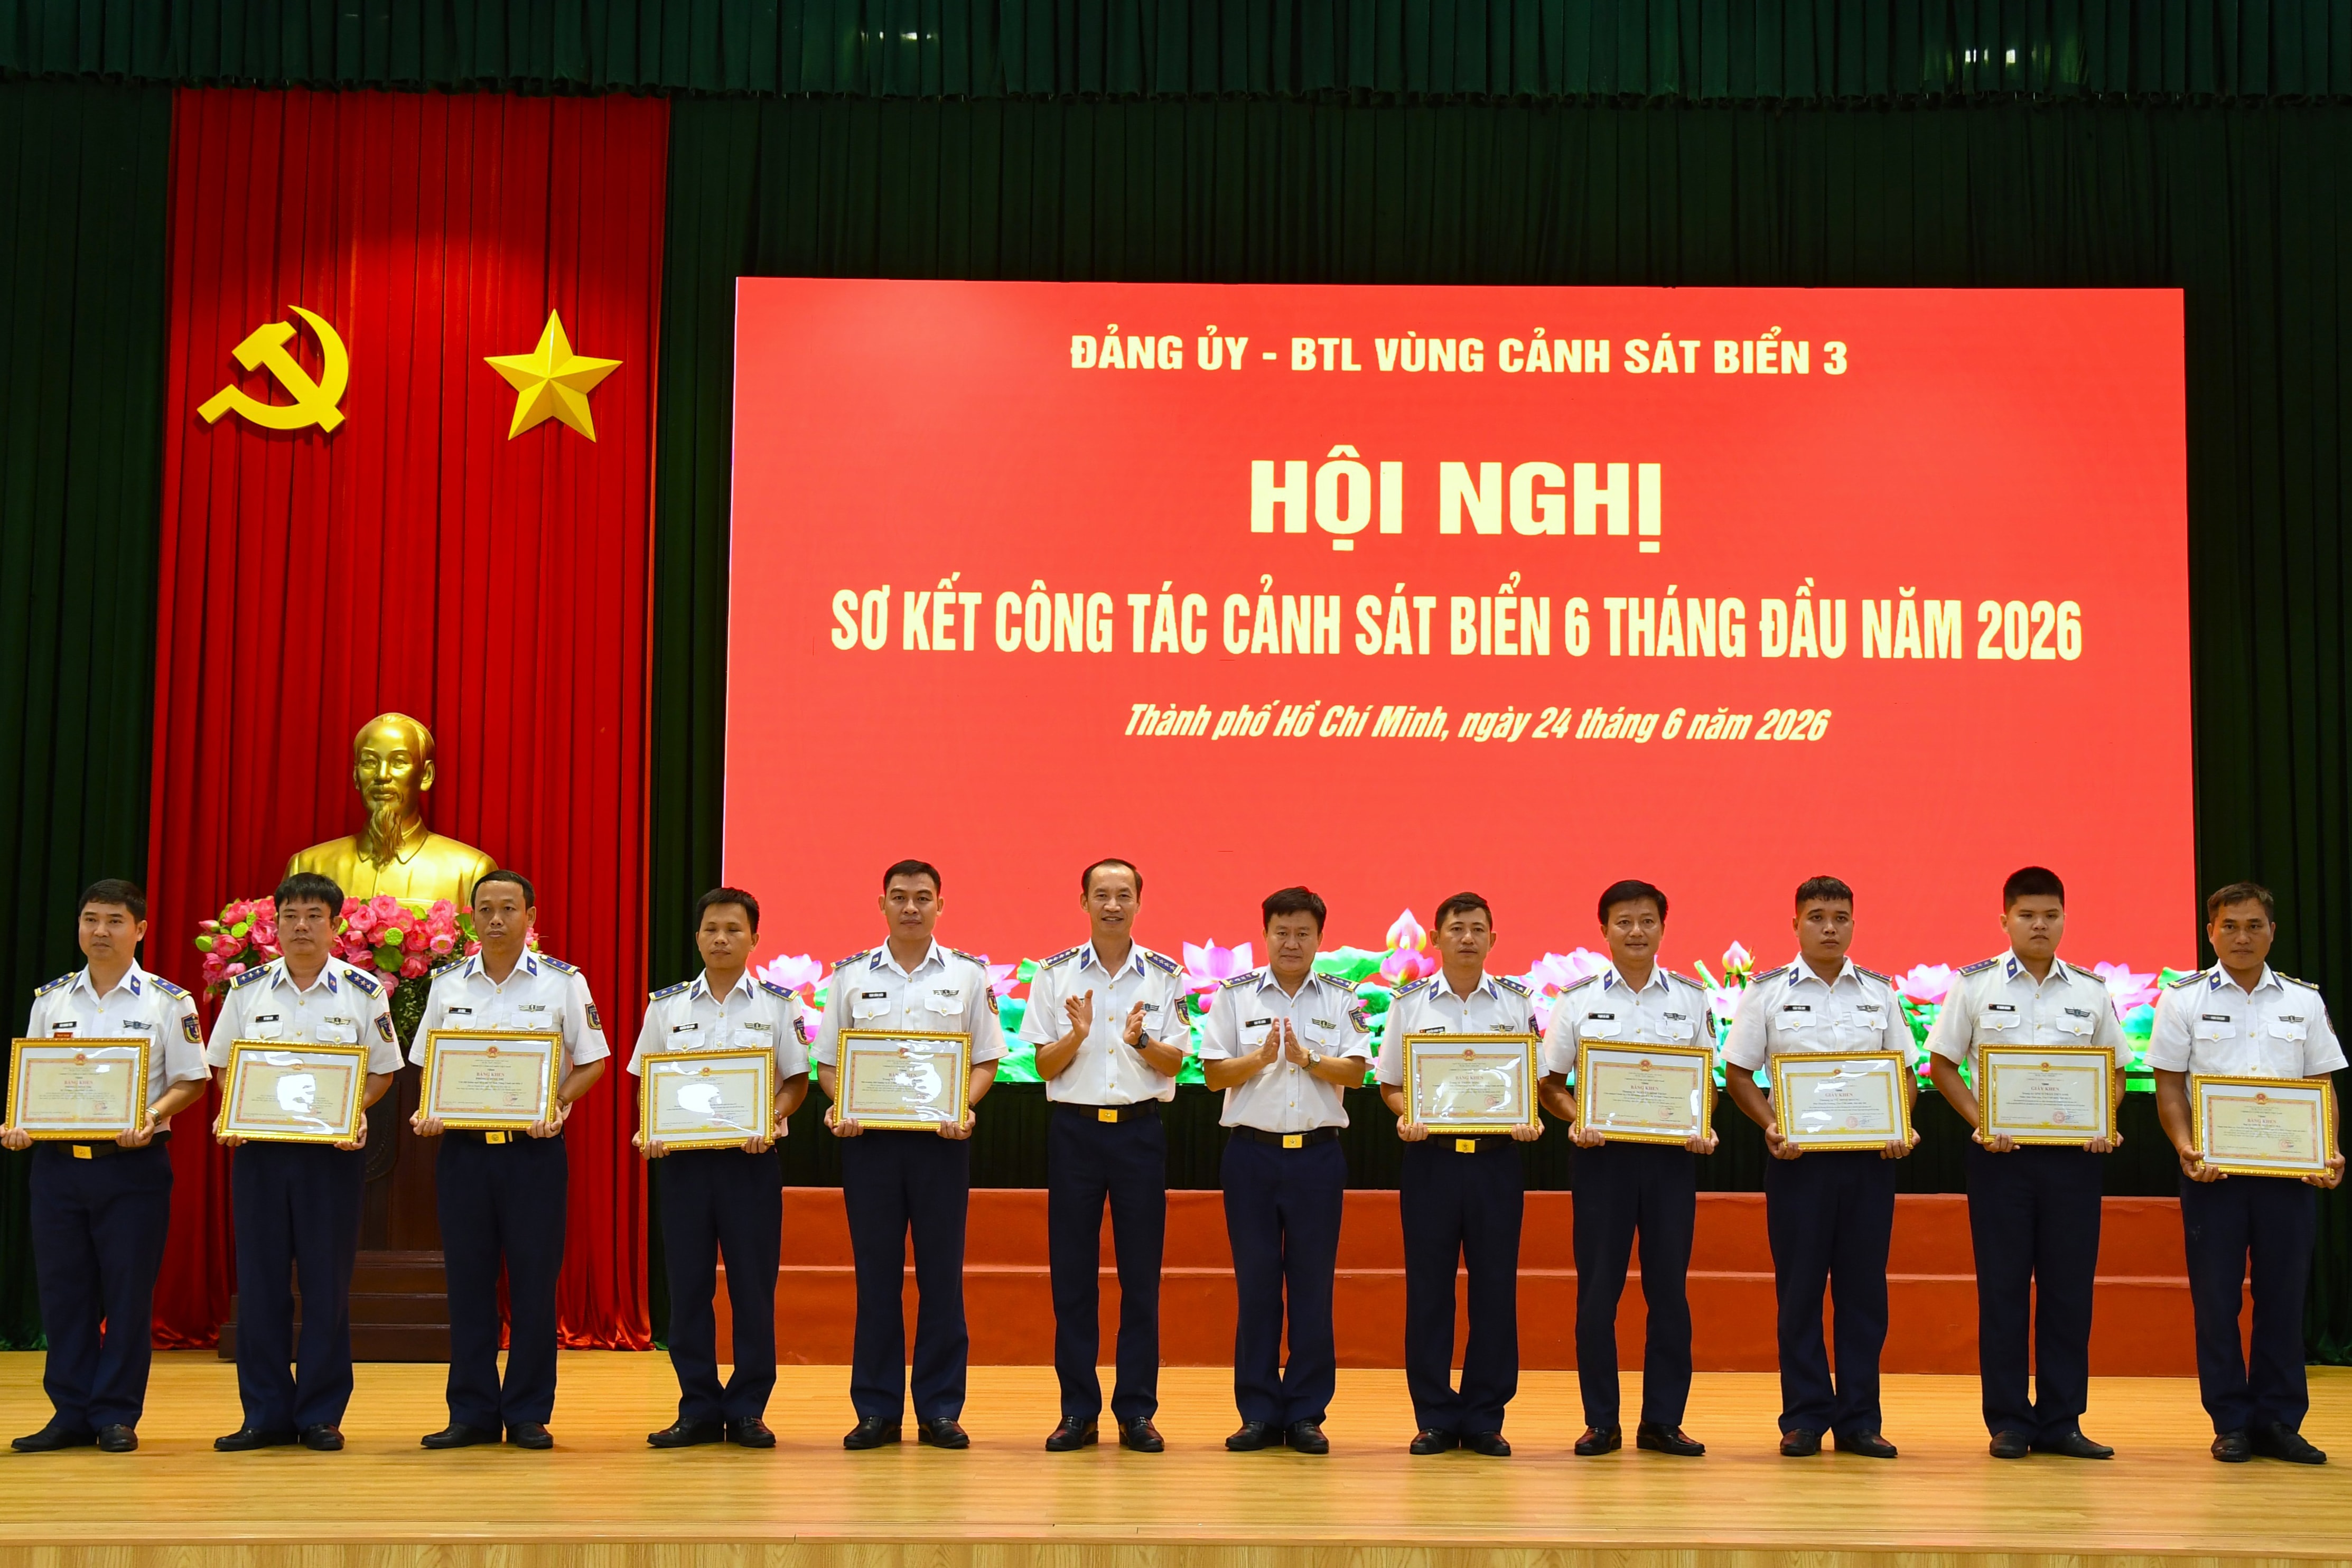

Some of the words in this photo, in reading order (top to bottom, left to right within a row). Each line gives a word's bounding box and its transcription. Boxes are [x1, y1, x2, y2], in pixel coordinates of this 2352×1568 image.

[1070, 324, 1182, 369] ĐẢNG
[1198, 325, 1248, 370] ỦY
[1292, 338, 1361, 371] BTL
[1375, 331, 1483, 372] VÙNG
[1499, 328, 1609, 372] CẢNH
[1625, 333, 1700, 373] SÁT
[1714, 326, 1809, 374] BIỂN
[1824, 341, 1847, 375] 3
[1251, 445, 1402, 550] HỘI
[1440, 462, 1661, 553] NGHỊ
[832, 585, 890, 650] SƠ
[903, 572, 982, 651] KẾT
[996, 580, 1113, 652] CÔNG
[1128, 581, 1207, 654] TÁC
[1224, 574, 1340, 654] CẢNH
[1356, 583, 1436, 655] SÁT
[1451, 572, 1550, 655] BIỂN
[1565, 598, 1590, 656] 6
[1604, 585, 1746, 658] THÁNG
[1759, 577, 1846, 658] ĐẦU
[1862, 587, 1962, 659] NĂM
[1977, 601, 2082, 660] 2026
[1125, 704, 1211, 736] Thành
[1211, 700, 1280, 740] phố
[1273, 701, 1321, 737] Hồ
[1319, 705, 1373, 737] Chí
[1371, 706, 1449, 741] Minh,
[1458, 706, 1532, 742] ngày
[1532, 707, 1572, 738] 24
[1575, 707, 1659, 743] tháng
[1662, 708, 1686, 739] 6
[1686, 707, 1752, 740] năm
[1754, 708, 1832, 741] 2026
